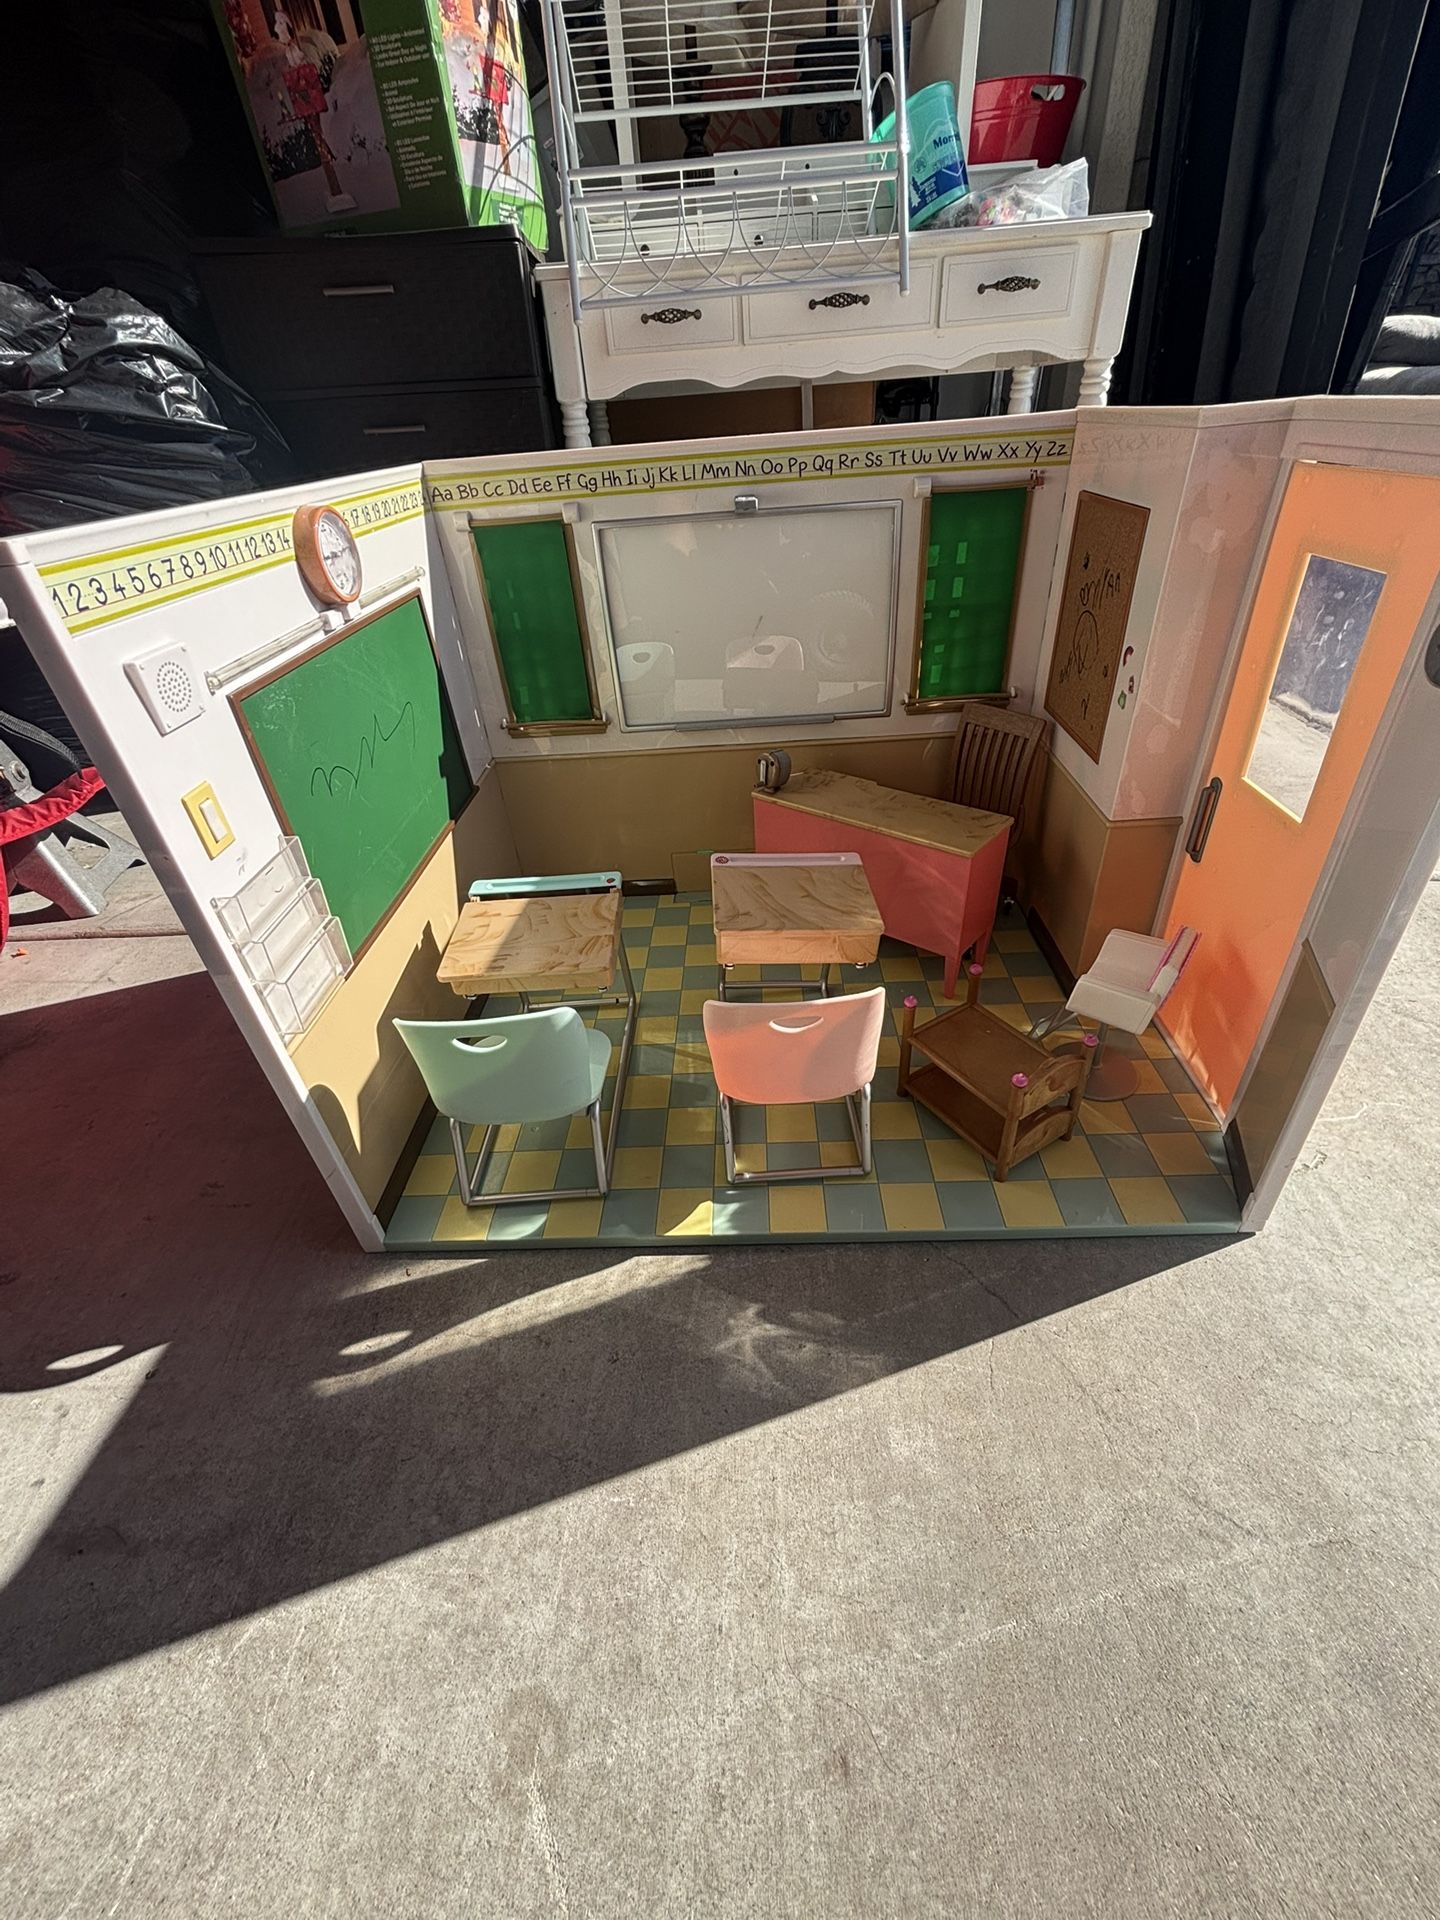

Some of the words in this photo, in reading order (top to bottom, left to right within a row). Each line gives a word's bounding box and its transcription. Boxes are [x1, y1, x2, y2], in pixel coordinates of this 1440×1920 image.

[431, 486, 453, 503] Aa
[456, 483, 479, 500] Bb
[482, 481, 504, 497] Cc
[507, 478, 529, 495] Dd
[532, 477, 553, 493] Ee
[556, 473, 572, 491] Ff
[577, 473, 598, 493] Gg
[601, 470, 622, 487] Hh
[626, 469, 638, 486] Ii
[642, 464, 656, 489] Jj
[658, 466, 679, 483] Kk
[682, 463, 696, 481] Ll
[701, 463, 731, 480] Mm
[735, 460, 756, 477] Nn
[760, 458, 783, 475] Oo
[788, 457, 808, 478] Pp
[812, 454, 834, 476] Qq
[838, 453, 860, 470] Rr
[864, 451, 883, 468] Ss
[888, 449, 907, 466] Tt
[911, 449, 932, 465] Uu
[937, 447, 958, 463] Vv
[963, 444, 993, 461] Ww
[997, 442, 1020, 459] Xx
[1025, 441, 1042, 463] Yy
[1046, 441, 1068, 457] Zz
[53, 587, 69, 617] 1
[67, 583, 90, 612] 2
[89, 577, 108, 606] 3
[112, 572, 127, 599] 4
[126, 567, 145, 594] 5
[147, 563, 162, 589] 6
[160, 558, 175, 585] 7
[180, 554, 194, 579] 8
[194, 550, 207, 575] 9
[209, 545, 227, 571] 10
[229, 540, 246, 565] 11
[244, 536, 261, 560] 12
[261, 532, 276, 555] 13
[276, 528, 291, 551] 14
[350, 508, 359, 527] 17
[361, 505, 371, 524] 18
[372, 503, 381, 521] 19
[381, 499, 392, 518] 20
[391, 497, 401, 514] 21
[400, 494, 410, 512] 22
[409, 492, 419, 509] 23
